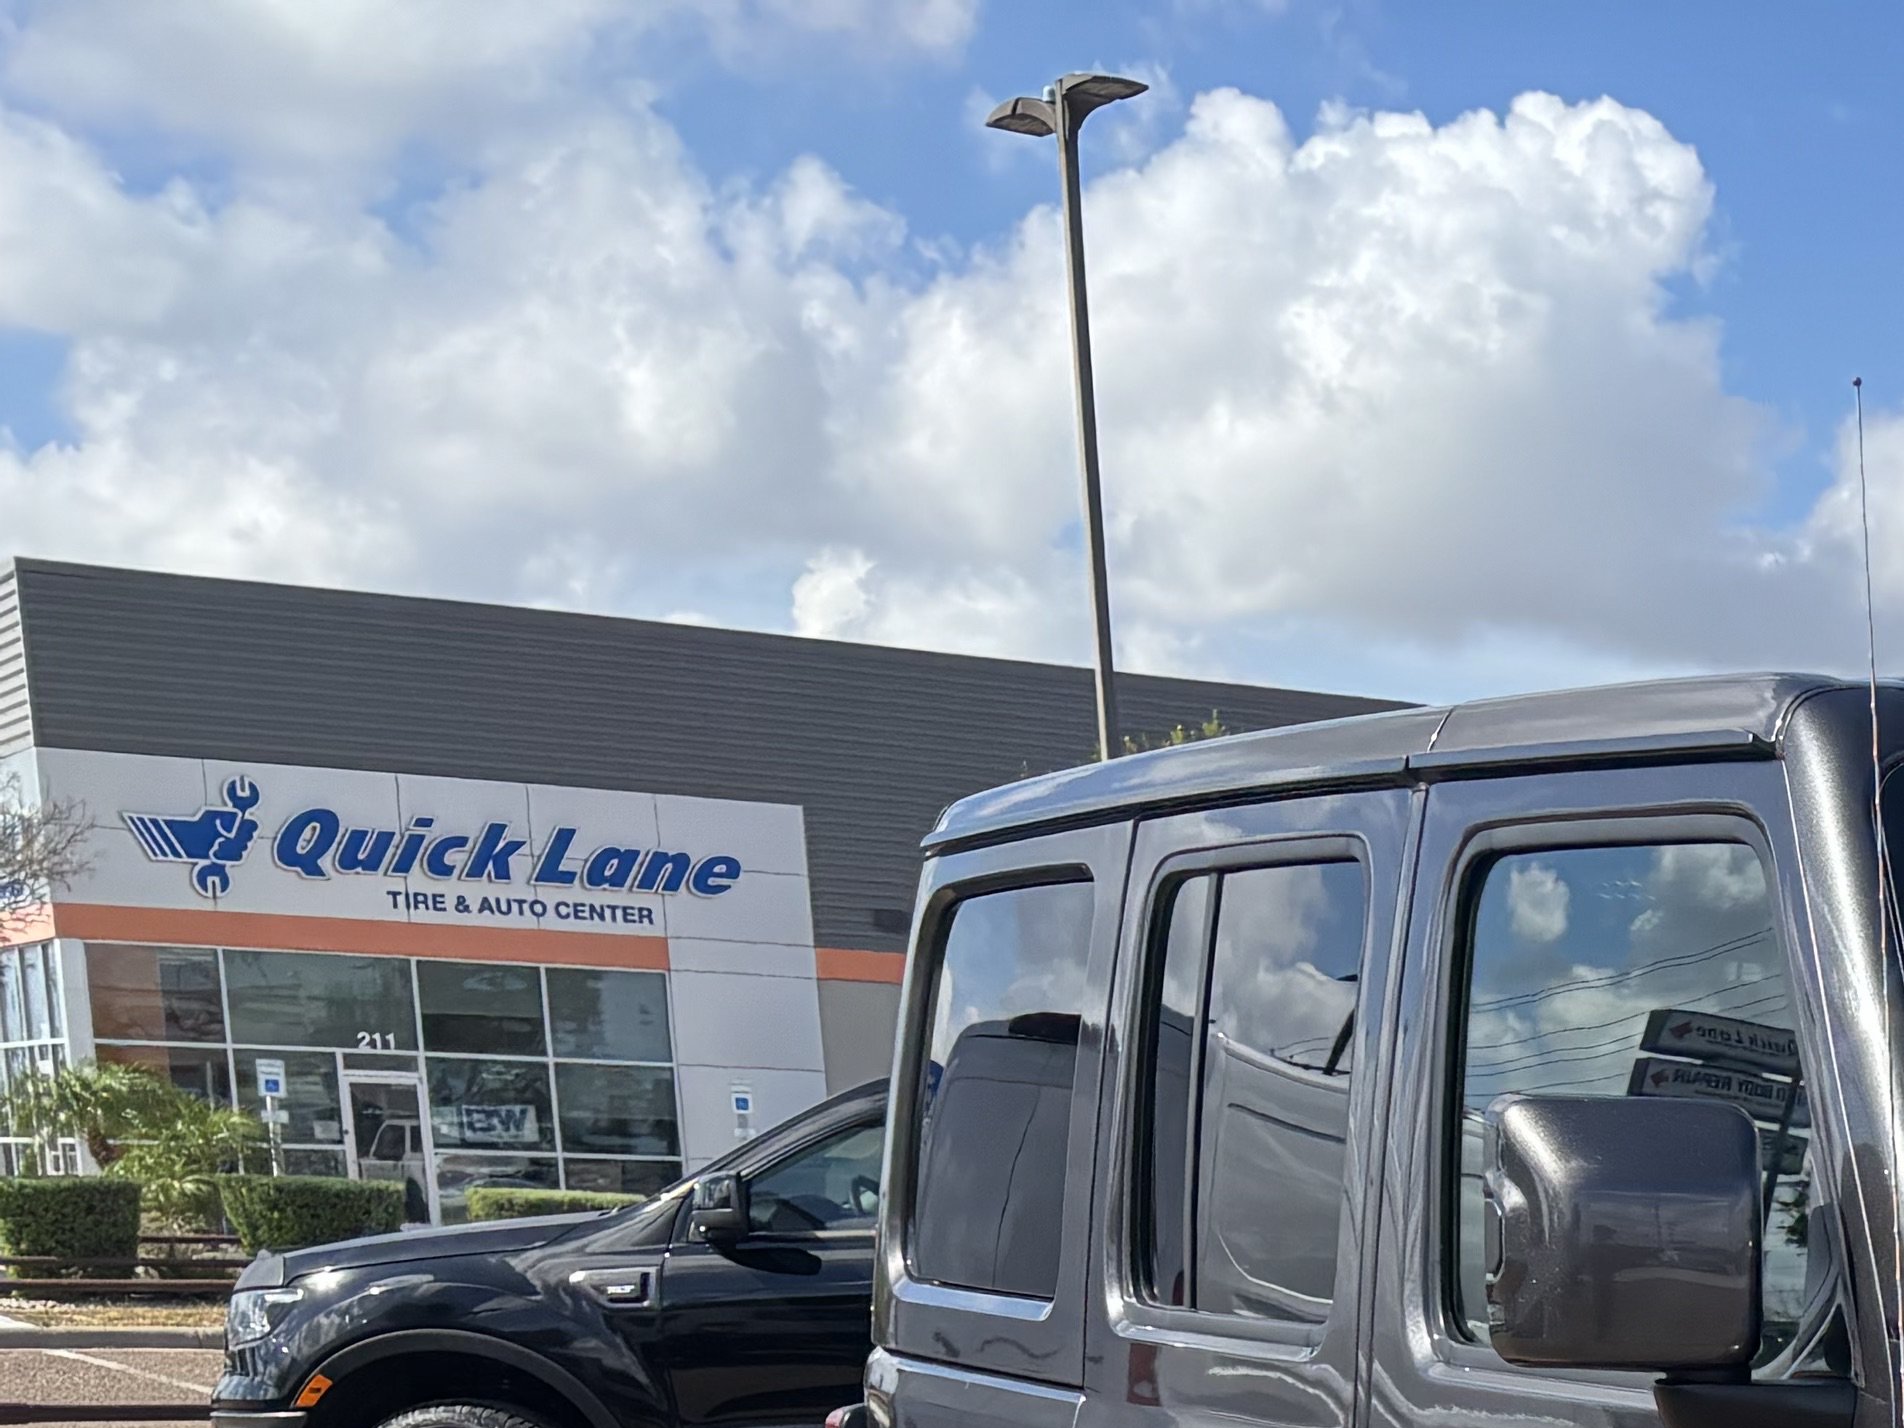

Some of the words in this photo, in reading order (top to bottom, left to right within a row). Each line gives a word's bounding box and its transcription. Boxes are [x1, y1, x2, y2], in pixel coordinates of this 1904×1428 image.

[274, 807, 527, 883] Quick
[532, 826, 742, 898] Lane
[386, 890, 447, 914] TIRE
[454, 896, 471, 914] &
[478, 898, 547, 919] AUTO
[554, 901, 654, 926] CENTER
[356, 1031, 396, 1051] 211
